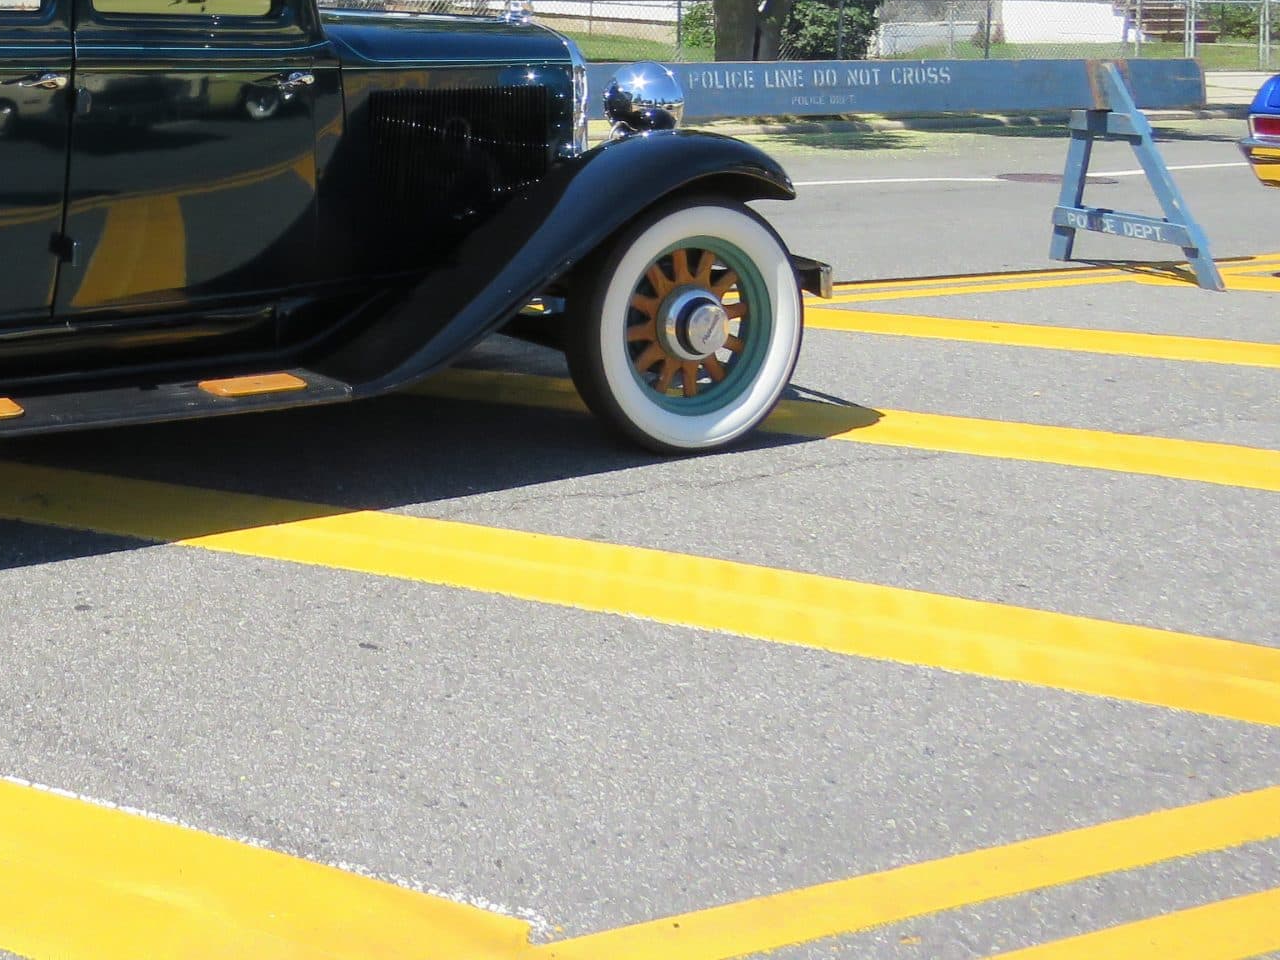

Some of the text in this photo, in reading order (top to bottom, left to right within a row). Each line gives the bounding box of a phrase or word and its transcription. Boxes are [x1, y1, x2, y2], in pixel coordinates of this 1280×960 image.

[689, 67, 951, 89] POLICE LINE DO NOT CROSS
[1123, 222, 1167, 242] DEPT.
